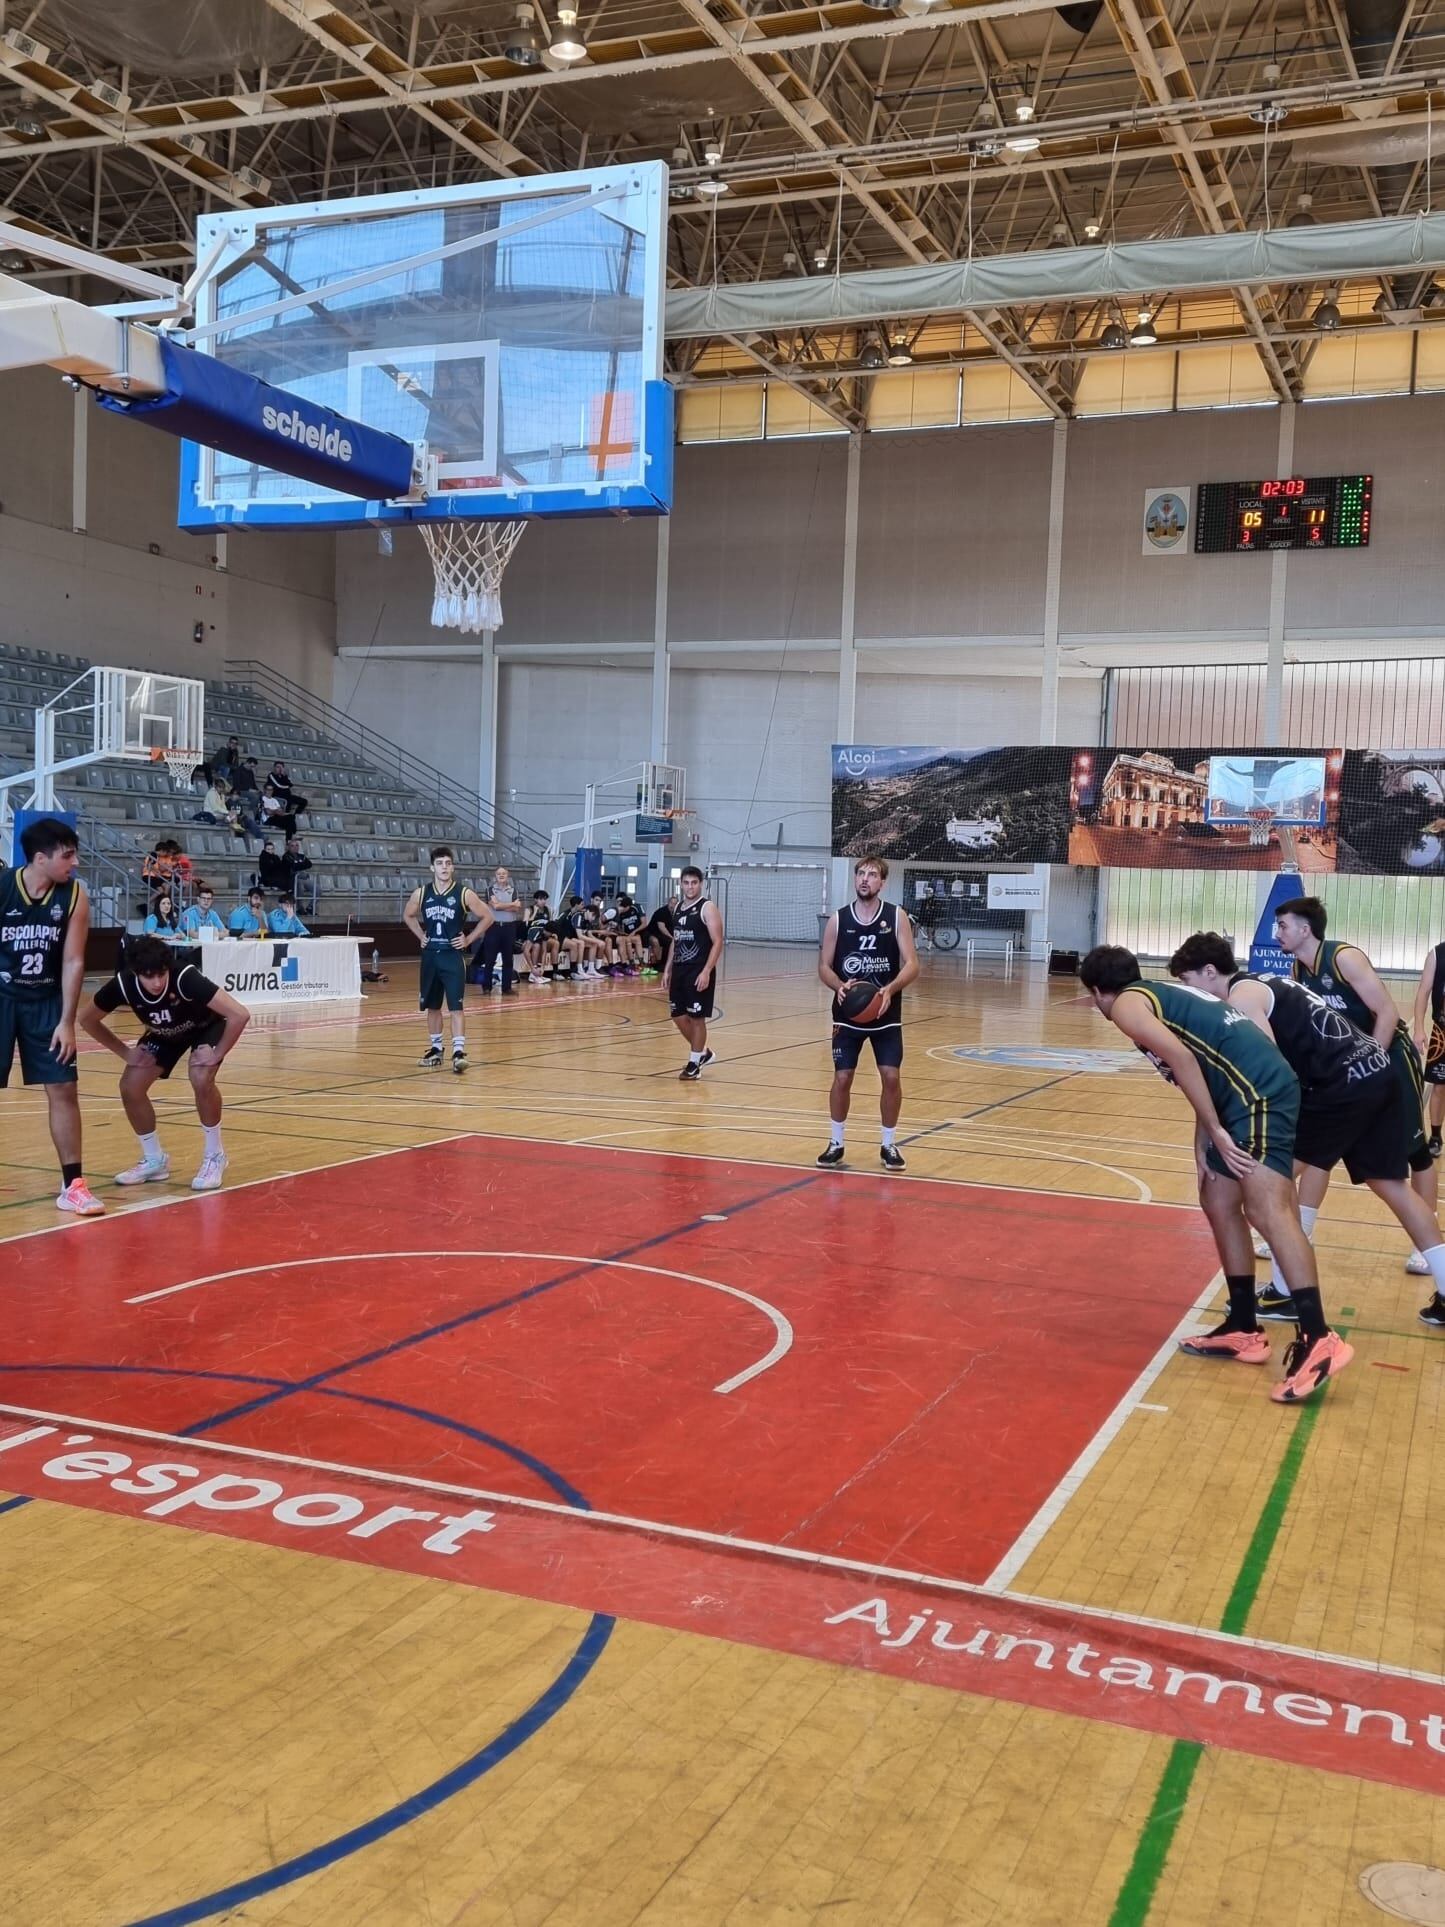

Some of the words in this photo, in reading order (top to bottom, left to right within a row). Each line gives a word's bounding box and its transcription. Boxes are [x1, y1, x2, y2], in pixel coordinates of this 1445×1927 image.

[262, 405, 352, 462] schelde
[1262, 481, 1305, 496] 02:03
[1281, 506, 1287, 516] 1
[1311, 510, 1325, 522] 11
[1244, 512, 1262, 526] 05
[1242, 531, 1250, 542] 3
[1312, 527, 1320, 539] 5
[838, 749, 876, 764] Alcoi
[858, 934, 877, 950] 22
[21, 952, 44, 975] 23
[862, 962, 890, 970] Levante
[224, 972, 280, 992] suma
[149, 1009, 172, 1025] 34
[824, 1598, 1445, 1753] Ajuntament
